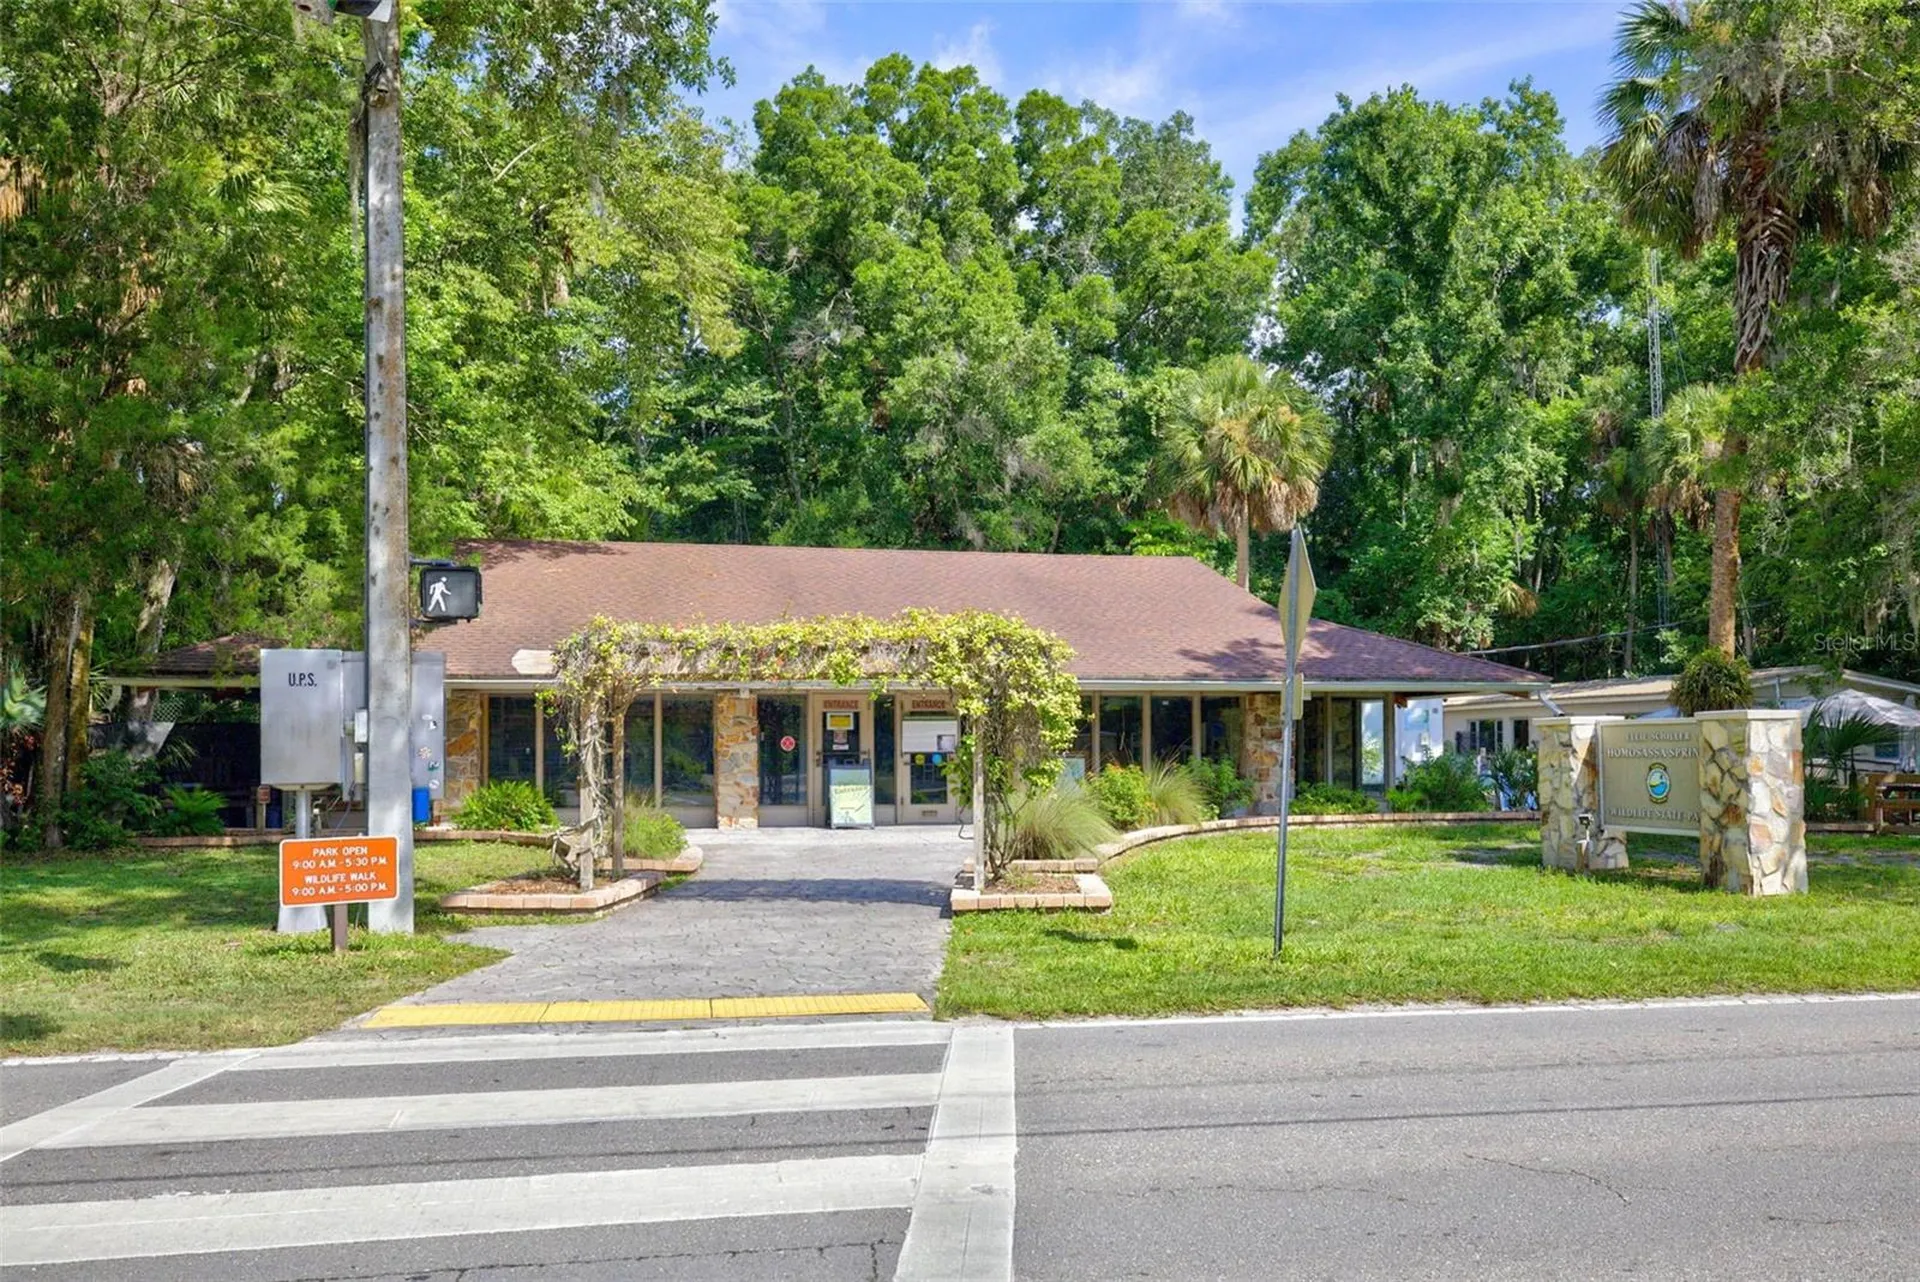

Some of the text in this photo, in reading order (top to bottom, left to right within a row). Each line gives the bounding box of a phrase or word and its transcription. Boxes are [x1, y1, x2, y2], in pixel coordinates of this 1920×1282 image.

[823, 700, 858, 709] ENTRANCE
[312, 846, 368, 857] PARK OPEN
[292, 860, 316, 869] 9:00
[345, 857, 368, 867] 5:30
[304, 872, 376, 884] WILDLIFE WALK
[291, 887, 315, 896] 9:00
[345, 883, 368, 893] 5:00
